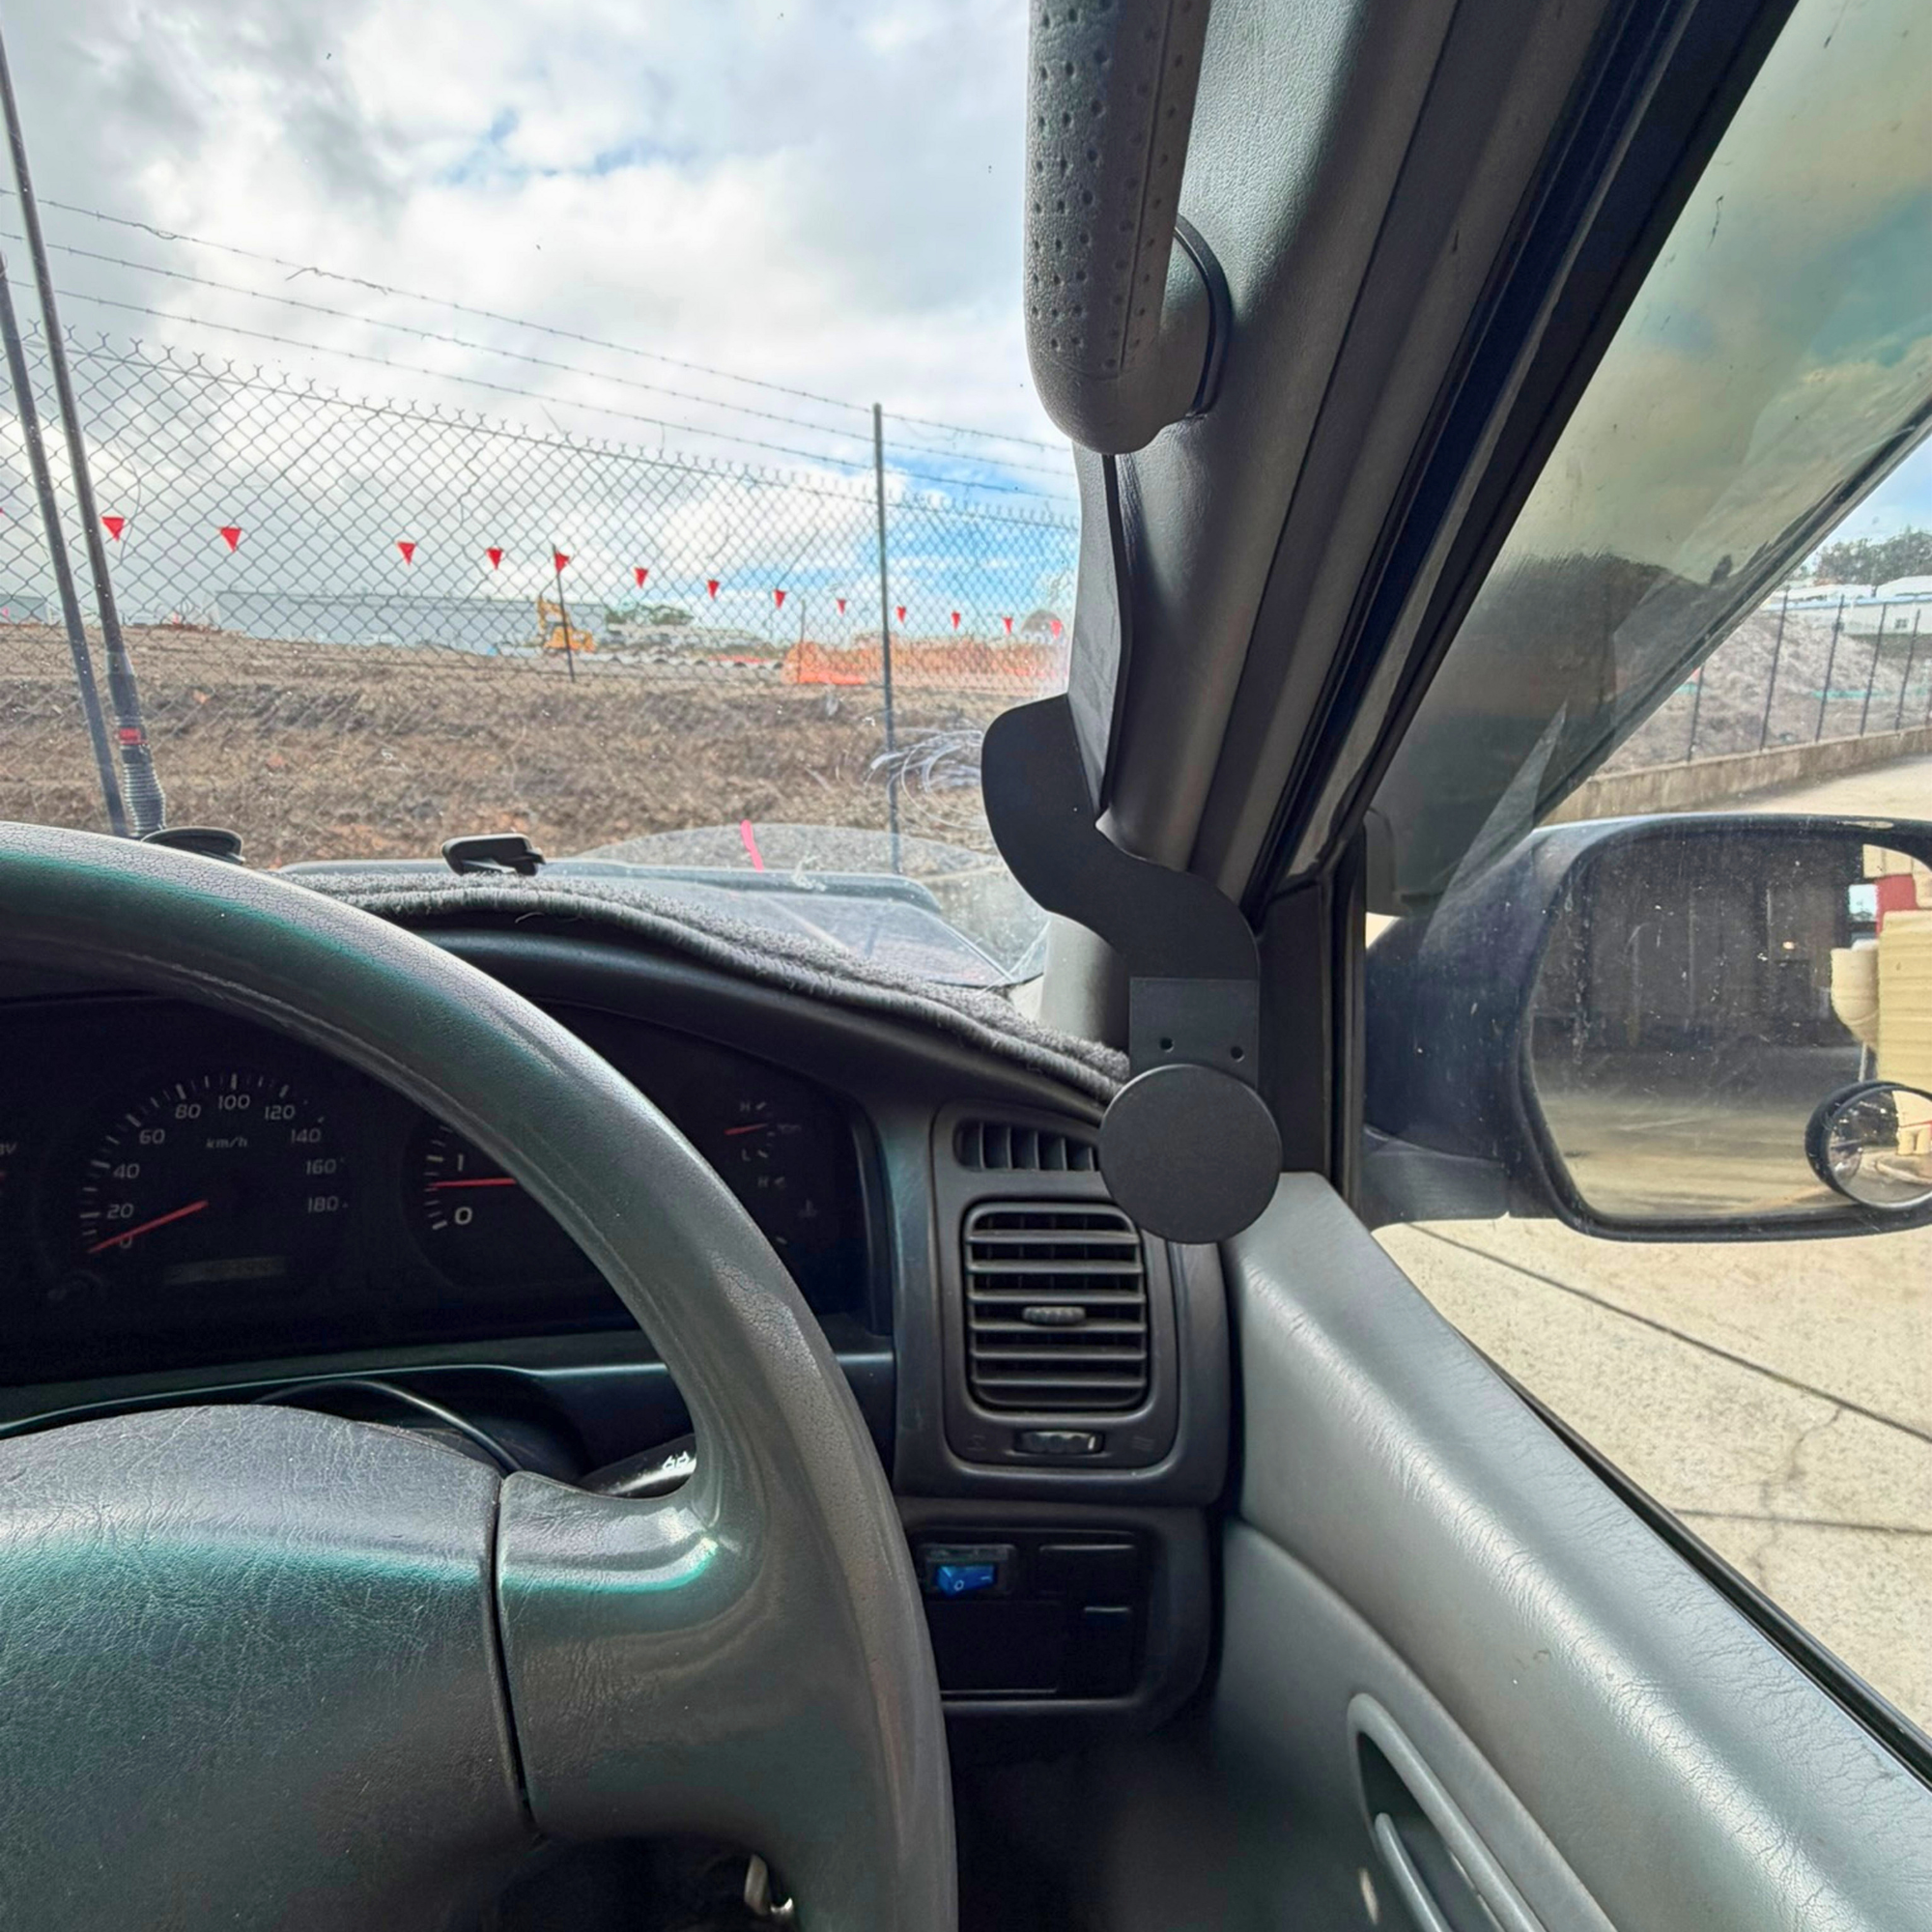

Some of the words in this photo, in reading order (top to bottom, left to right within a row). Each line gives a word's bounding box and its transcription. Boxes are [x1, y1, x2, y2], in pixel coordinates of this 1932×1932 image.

[218, 1094, 250, 1110] 100
[175, 1103, 201, 1119] 80
[265, 1105, 296, 1121] 120
[139, 1128, 165, 1145] 60
[206, 1137, 248, 1150] km/h
[291, 1128, 322, 1144] 140
[306, 1159, 337, 1175] 160
[457, 1153, 465, 1172] 1
[113, 1163, 140, 1179] 40
[107, 1204, 134, 1219] 20
[307, 1196, 339, 1212] 180
[454, 1207, 473, 1226] 0
